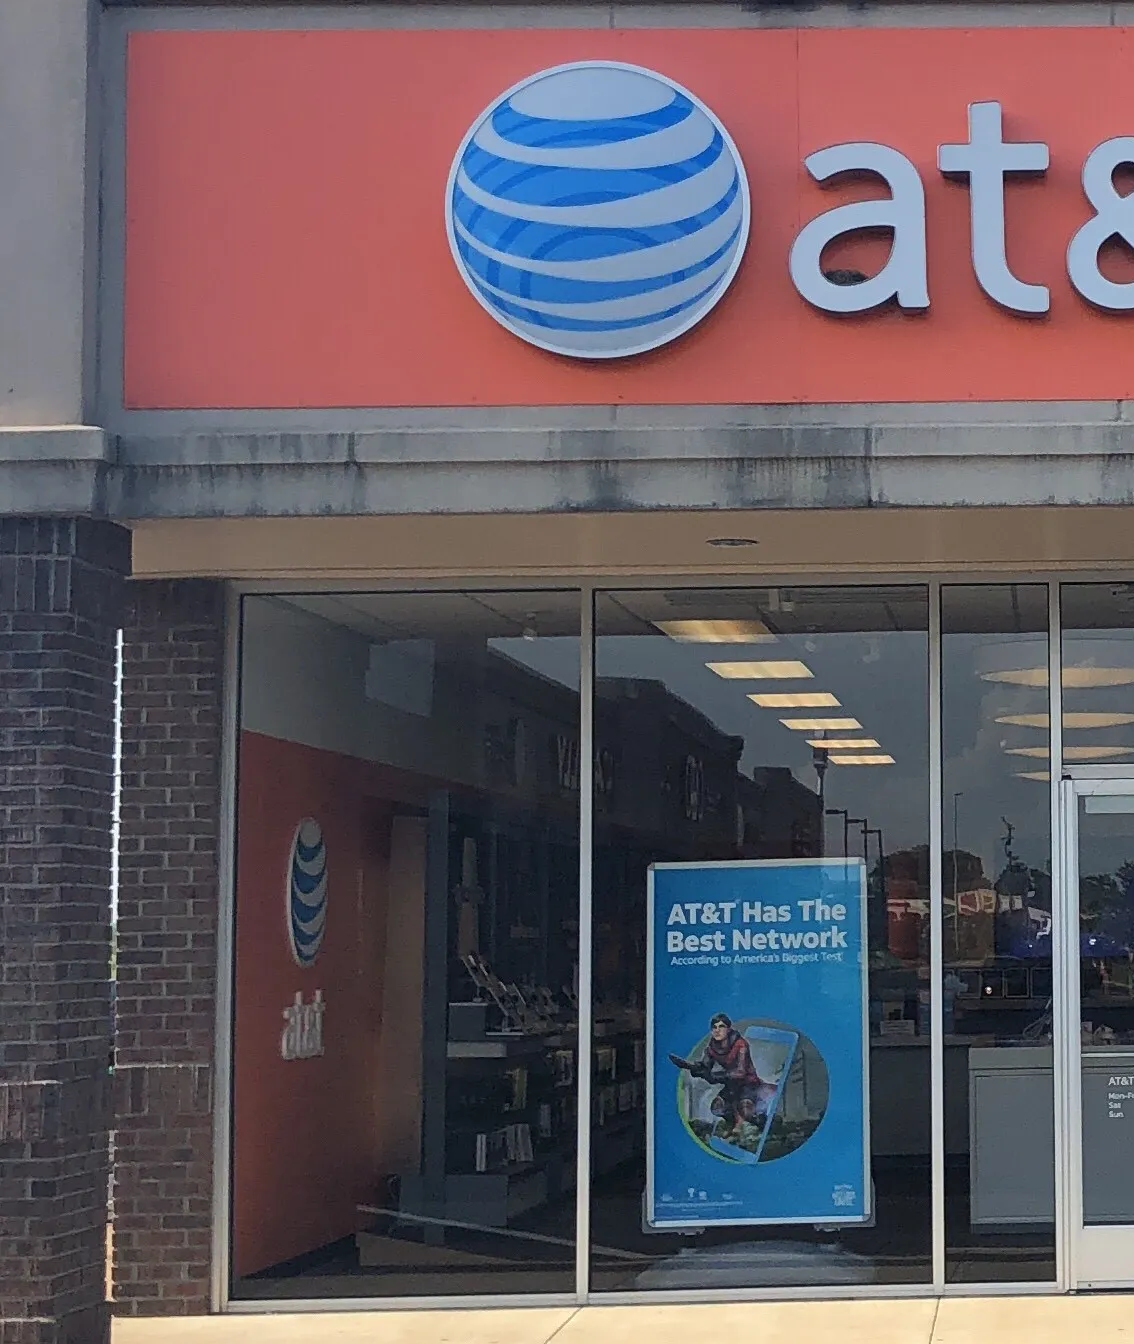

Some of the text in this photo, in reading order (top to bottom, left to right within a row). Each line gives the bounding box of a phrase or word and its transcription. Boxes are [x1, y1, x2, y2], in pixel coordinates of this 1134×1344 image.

[666, 898, 847, 926] AT&T Has The
[667, 925, 849, 953] Best Network
[670, 955, 719, 967] According
[720, 955, 732, 965] to
[733, 953, 780, 964] America's
[782, 952, 819, 964] Biggest
[1108, 1076, 1134, 1086] AT&T
